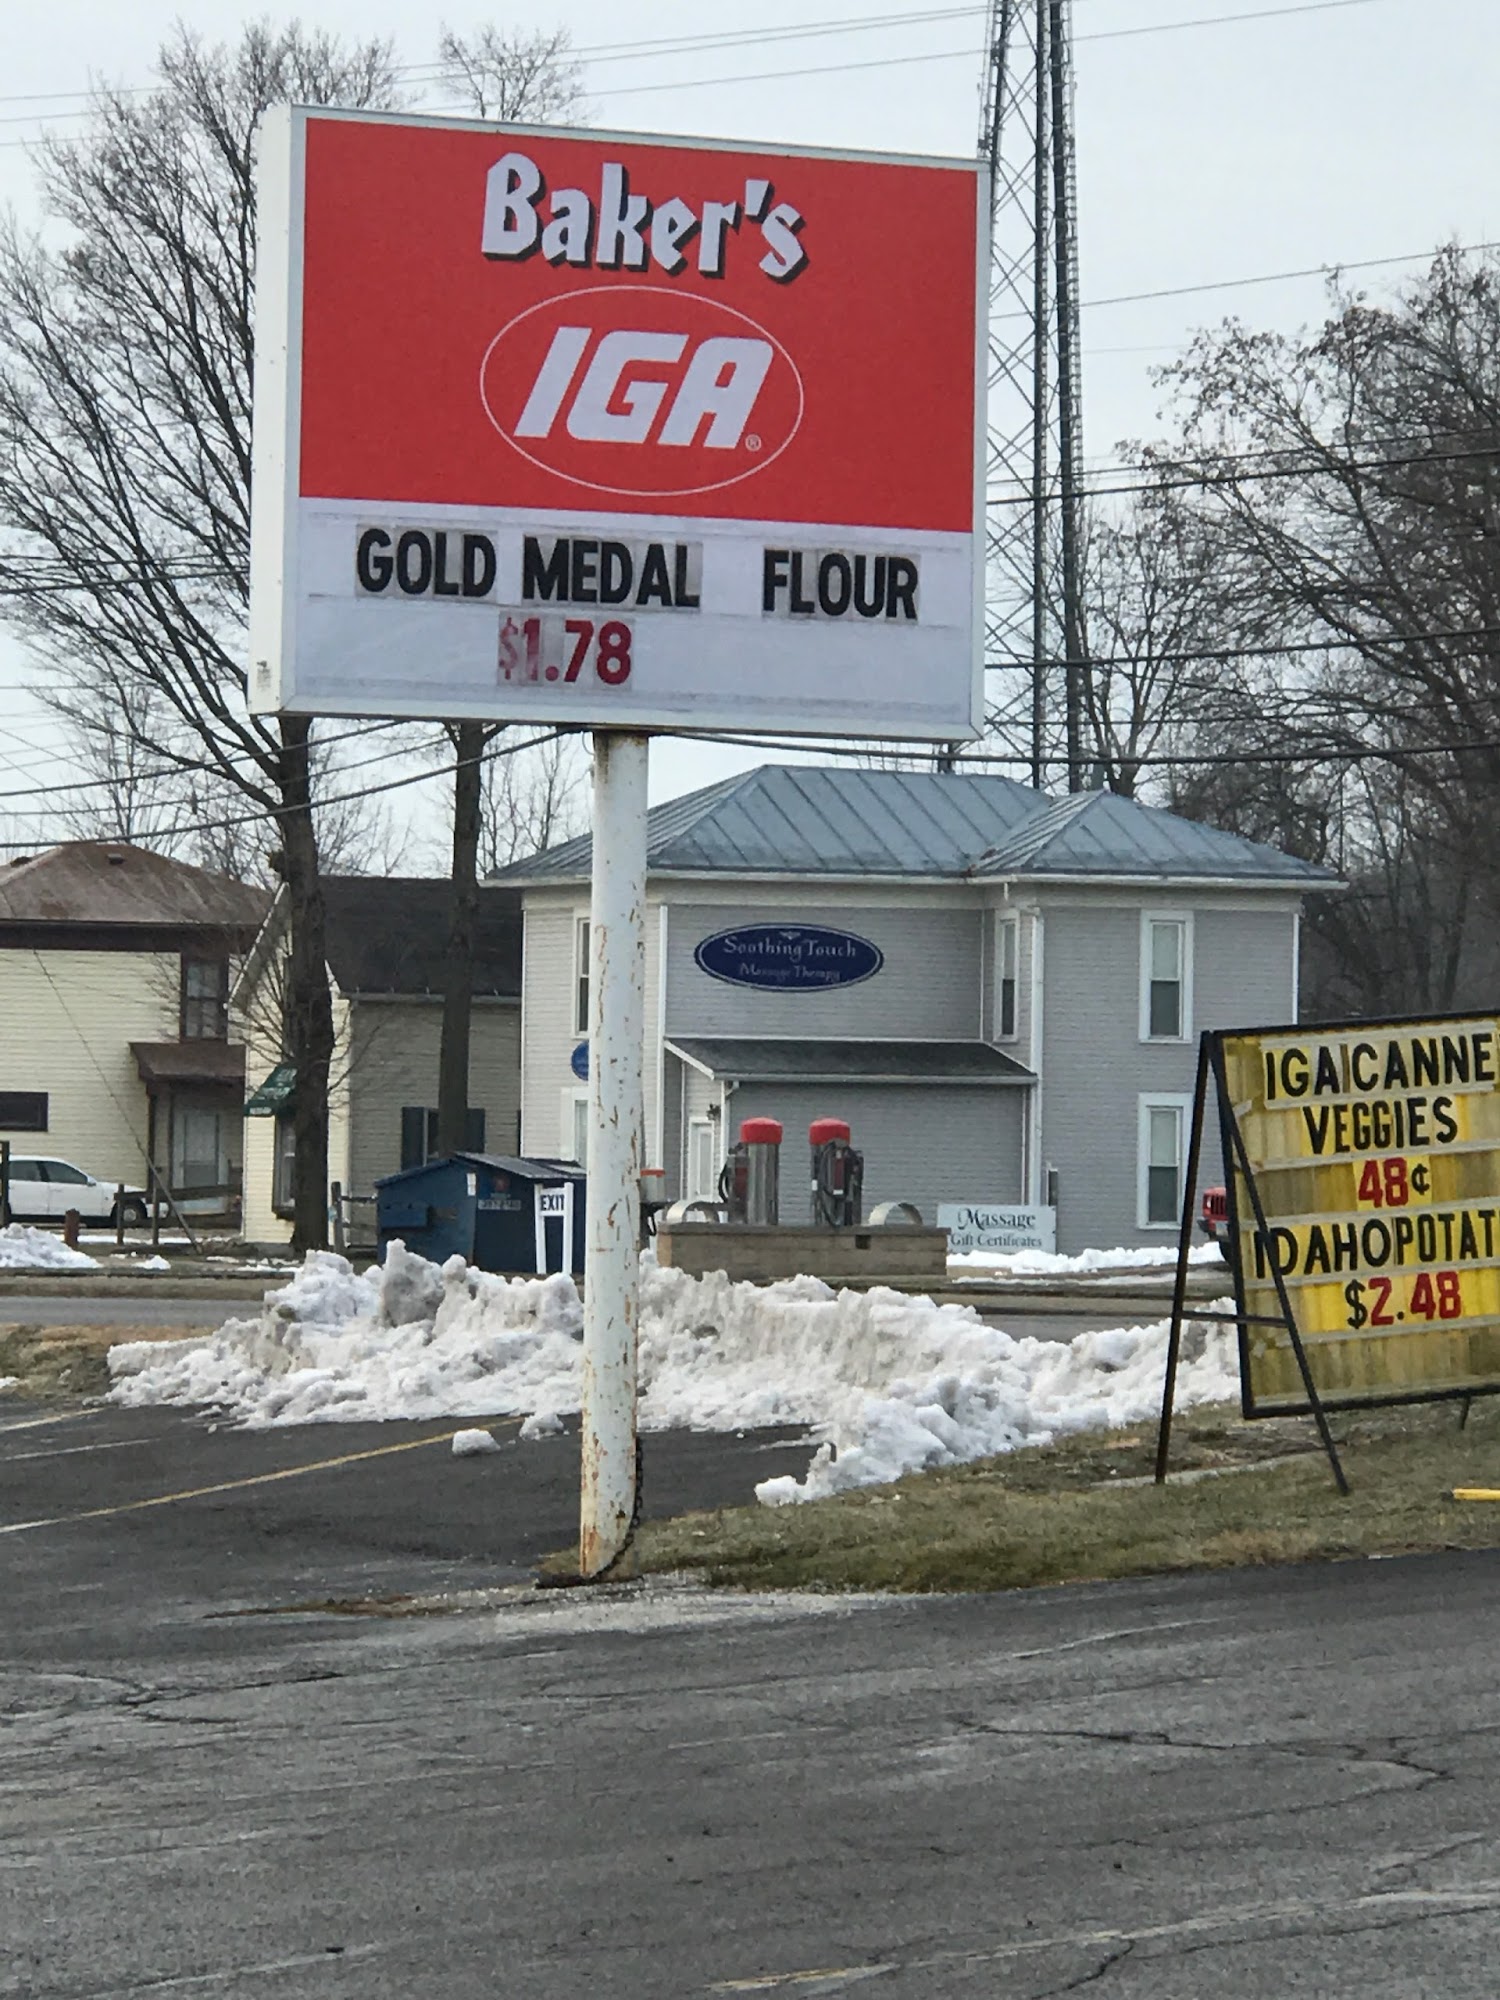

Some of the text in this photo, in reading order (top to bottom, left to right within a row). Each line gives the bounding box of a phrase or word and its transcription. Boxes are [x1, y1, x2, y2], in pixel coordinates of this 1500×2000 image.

[481, 151, 809, 284] Baker's
[513, 325, 775, 449] IGA
[356, 528, 918, 620] GOLD MEDAL FLOUR
[498, 616, 632, 686] $1.78
[724, 936, 856, 964] Soothing Touch
[1302, 1096, 1459, 1155] VEGGIES
[540, 1193, 565, 1212] EXIT
[1357, 1157, 1431, 1209] 48¢
[957, 1207, 1036, 1231] Massage
[1344, 1270, 1463, 1330] $2.48
